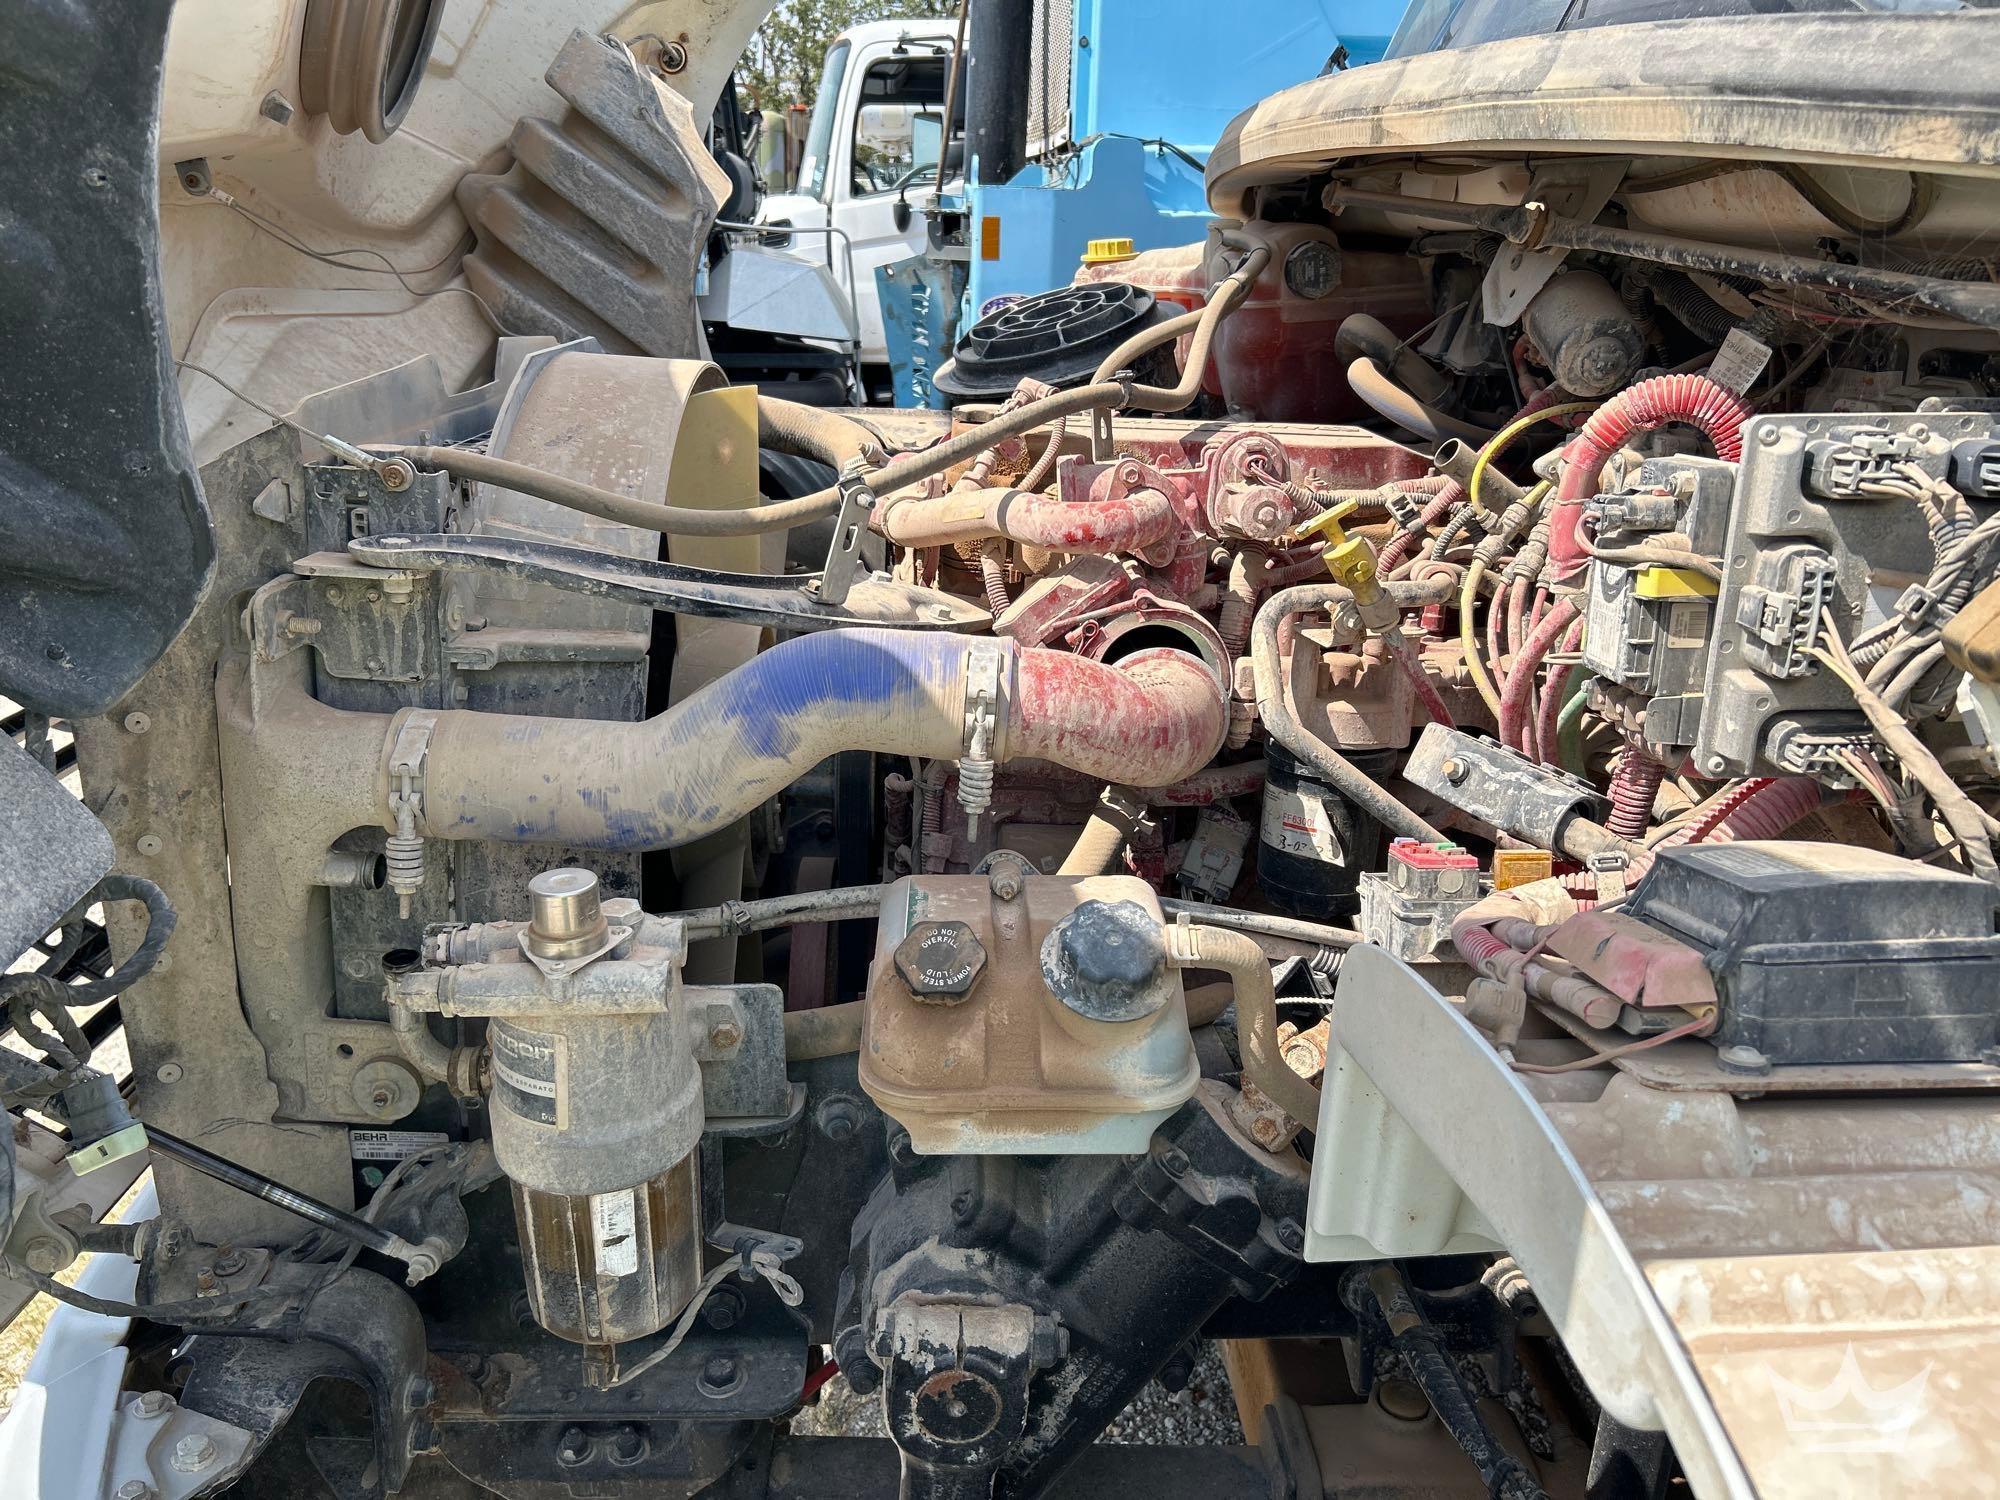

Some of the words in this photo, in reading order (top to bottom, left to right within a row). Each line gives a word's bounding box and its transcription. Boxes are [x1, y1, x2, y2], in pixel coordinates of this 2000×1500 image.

[941, 928, 957, 937] NOT
[921, 935, 960, 949] OVERFILL
[947, 965, 971, 985] POWER
[353, 1132, 388, 1141] BEHR
